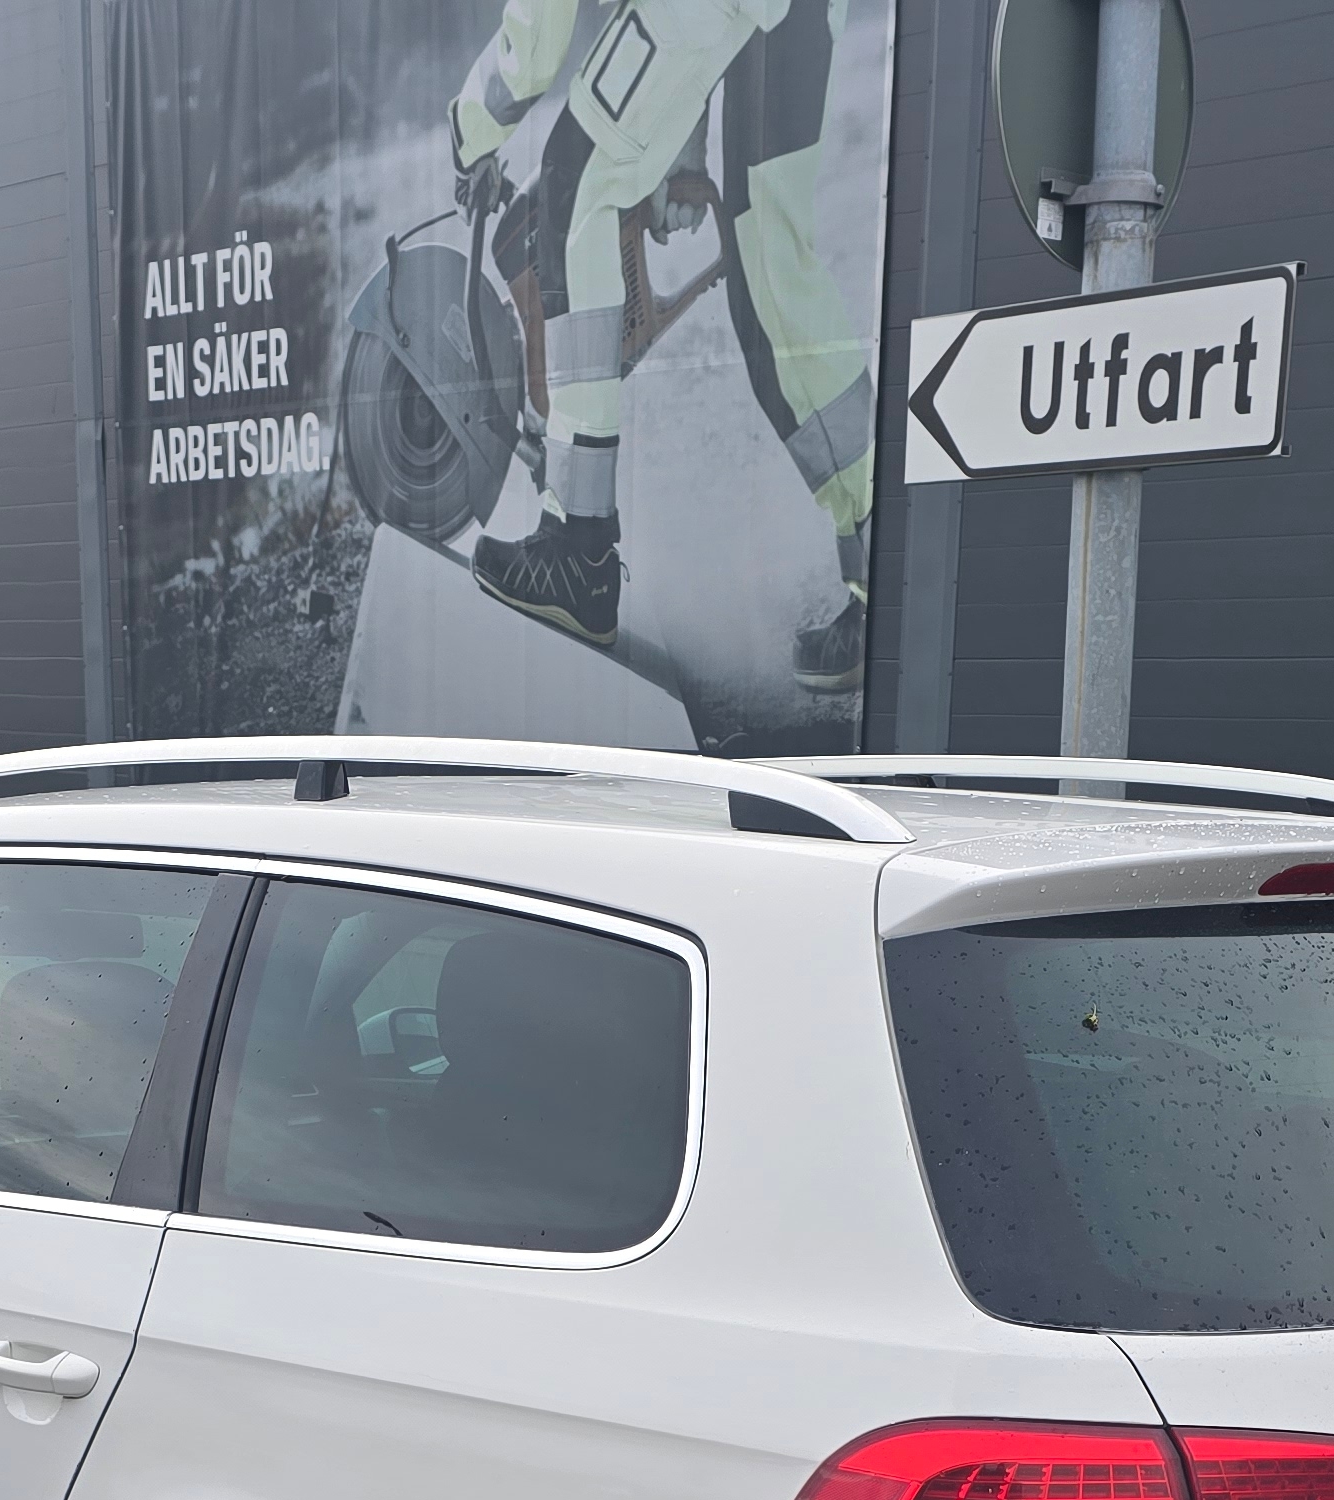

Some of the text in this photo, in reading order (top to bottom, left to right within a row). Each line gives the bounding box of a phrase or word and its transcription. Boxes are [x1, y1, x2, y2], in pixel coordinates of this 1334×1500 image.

[144, 230, 273, 319] ALLT FÖR
[146, 321, 289, 402] EN SÄKER
[1020, 316, 1258, 435] Utfart
[149, 411, 331, 484] ARBETSDAG.
